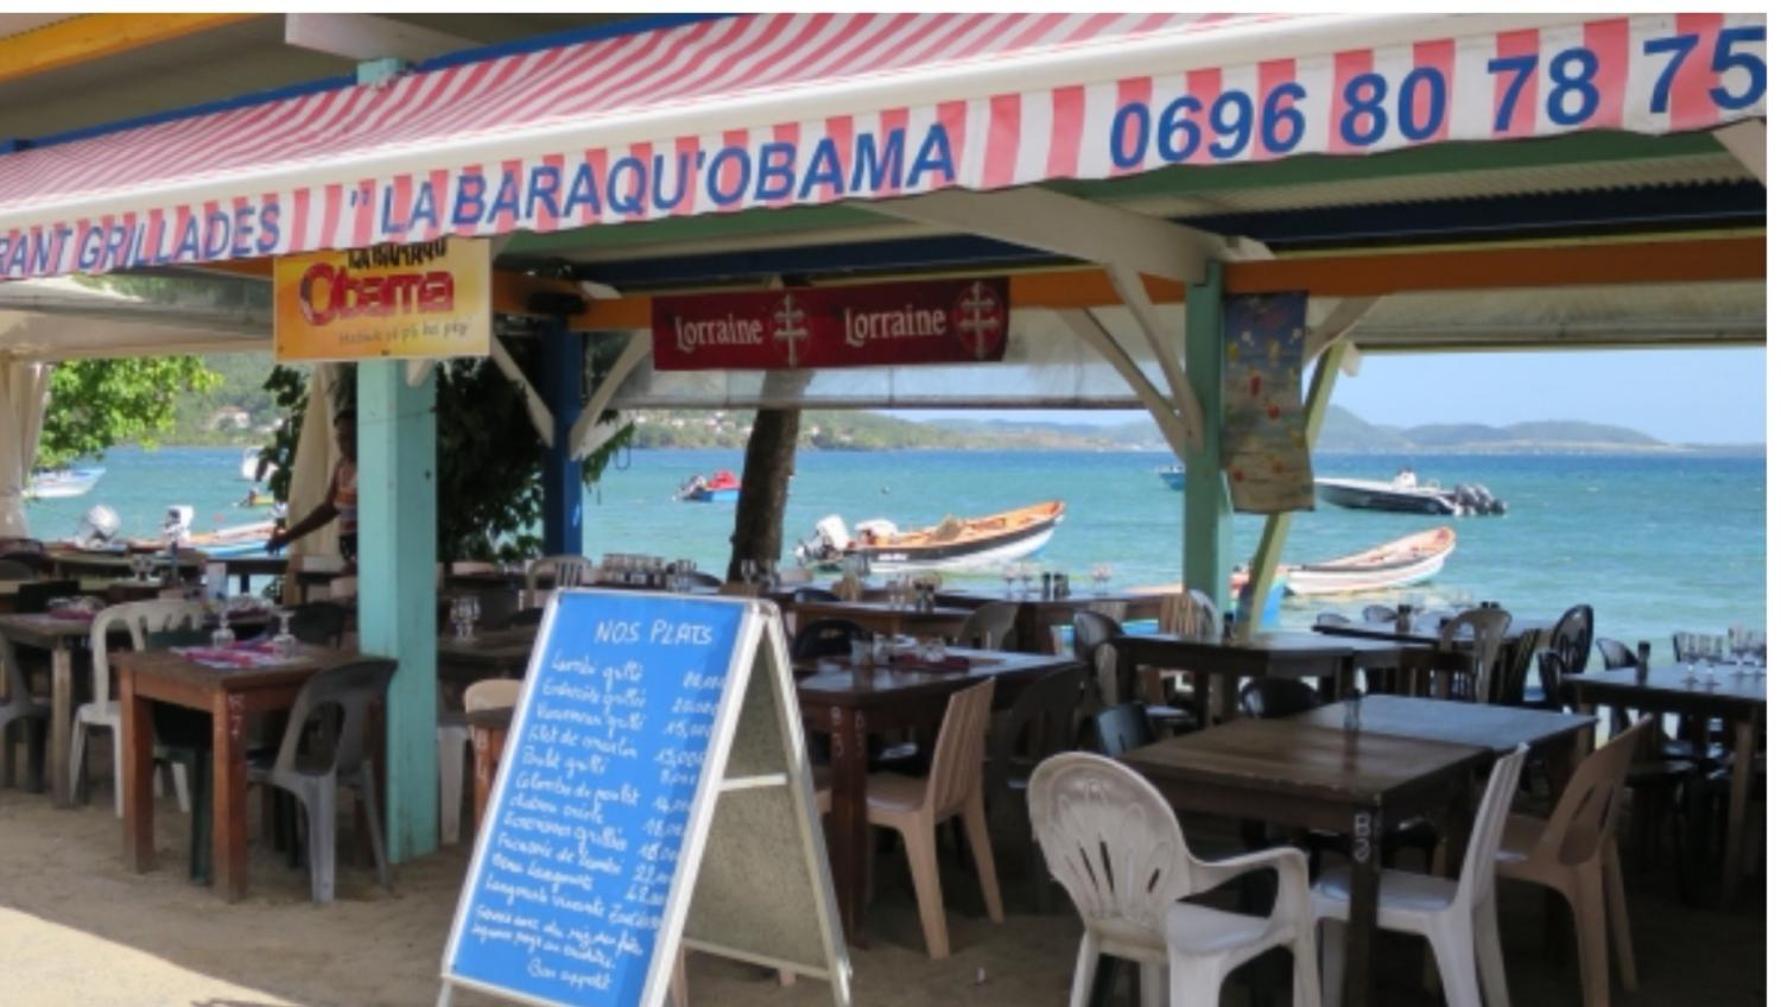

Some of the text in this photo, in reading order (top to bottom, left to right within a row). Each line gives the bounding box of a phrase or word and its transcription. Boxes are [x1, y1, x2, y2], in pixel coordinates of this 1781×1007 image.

[1110, 26, 1767, 169] 0696 80 78 75
[76, 204, 280, 271] GRILLADES
[451, 122, 956, 226] BARAQU'OBAMA
[301, 262, 454, 326] Obama
[675, 314, 764, 351] Lorraine
[844, 305, 947, 347] Lorraine
[594, 618, 713, 645] NOS PLATS
